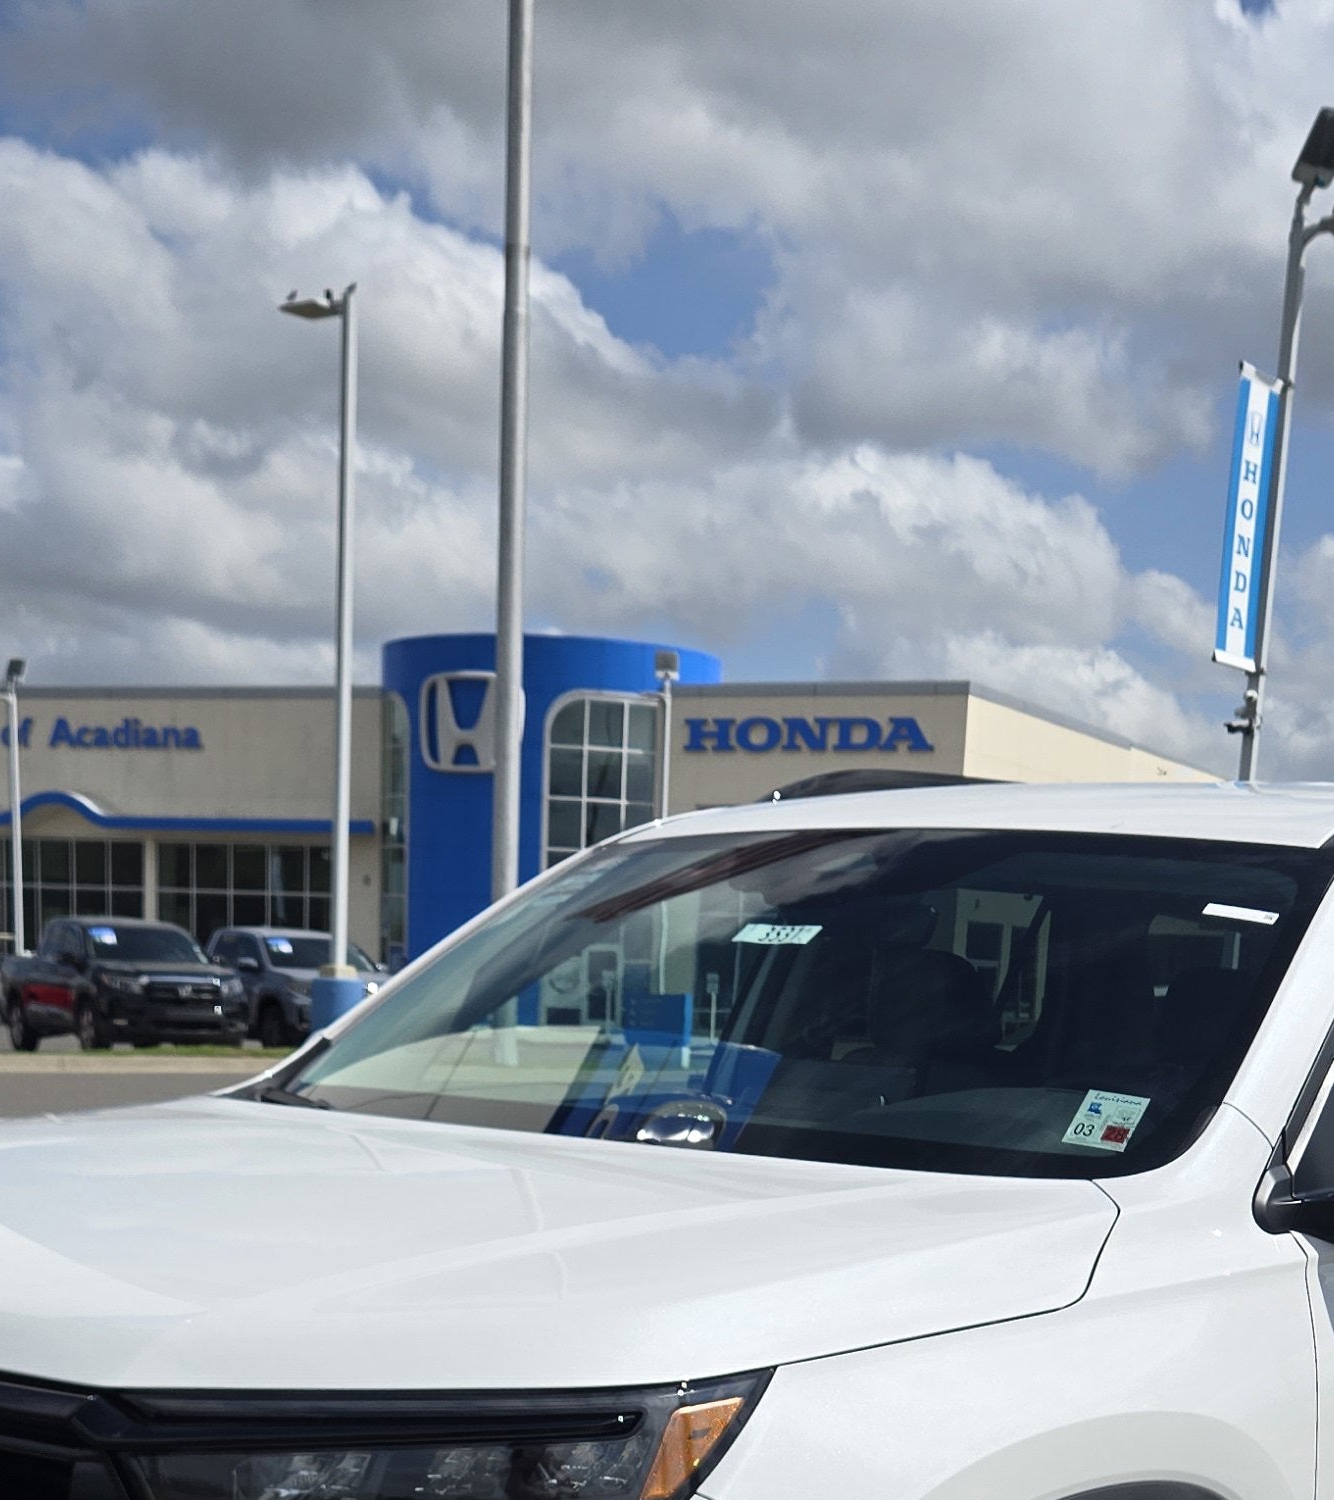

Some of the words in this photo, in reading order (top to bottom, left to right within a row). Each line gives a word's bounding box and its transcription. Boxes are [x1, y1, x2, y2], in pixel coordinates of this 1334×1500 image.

[1230, 461, 1258, 630] HONDA
[0, 716, 34, 748] of
[49, 716, 203, 748] Acadiana
[683, 716, 934, 752] HONDA
[1073, 1122, 1095, 1137] 03
